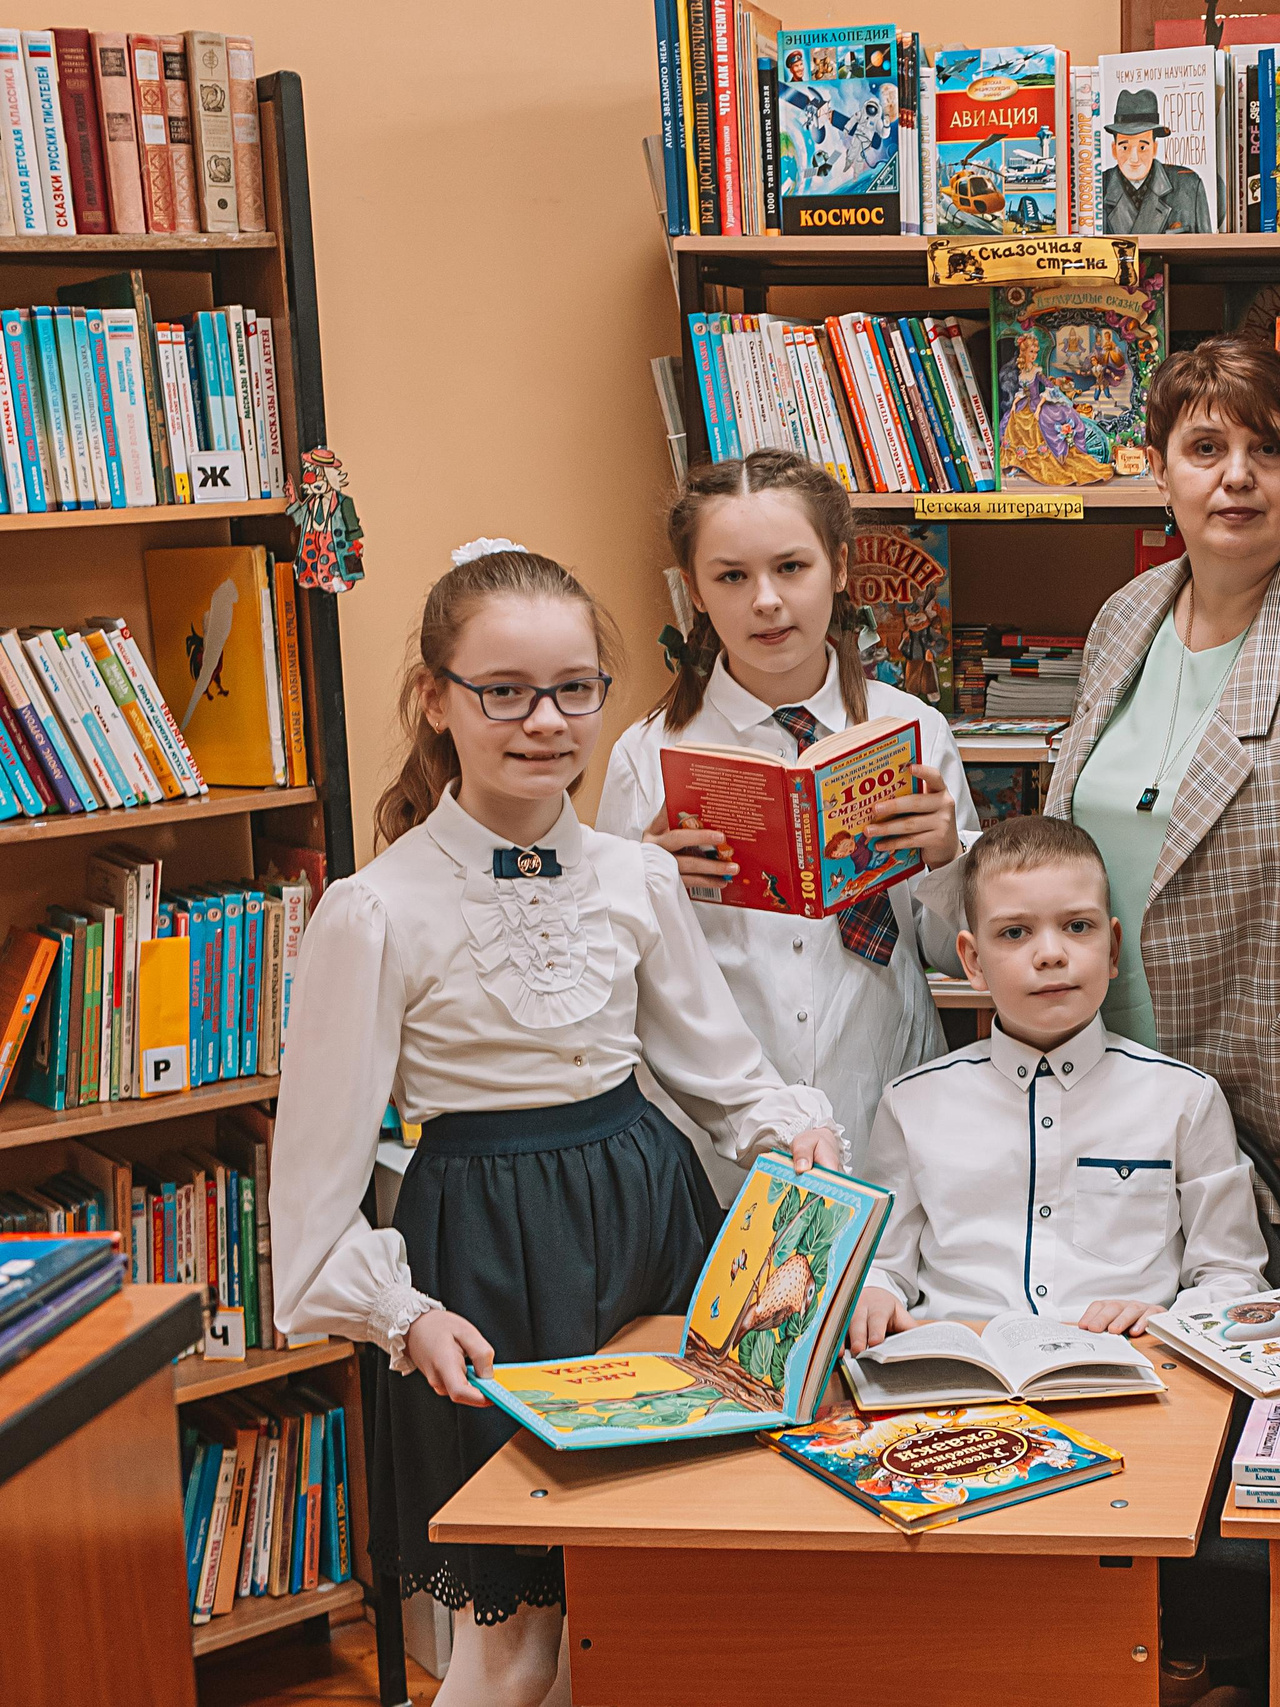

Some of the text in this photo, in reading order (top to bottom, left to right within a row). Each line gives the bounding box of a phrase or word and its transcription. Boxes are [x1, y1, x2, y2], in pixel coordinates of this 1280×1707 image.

[785, 28, 890, 48] ЭНЦИКЛОПЕДИЯ
[713, 0, 729, 116] ЧТО, КАК И ПОЧЕМУ?
[1115, 63, 1207, 83] ЧЕМУ Я МОГУ НАУЧИТЬСЯ
[658, 40, 674, 148] АТЛАС ЗВЕЗДНОГО НЕБА
[950, 107, 1039, 129] АВИАЦИЯ
[1162, 91, 1206, 134] СЕРГЕЯ
[1077, 112, 1093, 146] МИР
[4, 67, 36, 230] РУССКАЯ ДЕТСКАЯ КЛАССИКА
[34, 66, 69, 228] СКАЗКИ РУССКИХ ПИСАТЕЛЕЙ
[695, 101, 716, 195] ДОСТИЖЕНИЯ
[763, 85, 776, 215] 1000 тайн планеты Земля
[1163, 135, 1207, 167] КОРОЛЁВА
[721, 125, 735, 230] Удивительный мир техники
[1078, 149, 1094, 213] ПОЗНАЮ
[701, 199, 714, 225] ВСЕ
[800, 207, 885, 228] КОСМОС
[1025, 199, 1035, 218] NAVY
[978, 239, 1082, 262] Сказочная
[1036, 254, 1109, 274] страна
[259, 329, 280, 456] РАССКАЗЫ ДЛЯ ДЕТЕЙ
[876, 393, 888, 424] ЧТЕНИЕ
[885, 427, 907, 485] ВНЕКЛАССНОЕ
[198, 466, 231, 487] Ж
[914, 497, 1084, 519] Детская литература
[827, 777, 908, 820] СМЕШНЫХ
[840, 767, 895, 806] 100
[801, 870, 816, 901] 100
[153, 1059, 171, 1082] Р
[562, 1371, 637, 1385] ЛИСА
[896, 1429, 999, 1460] сказки
[910, 1437, 1009, 1468] волшебные
[933, 1448, 1011, 1474] Русские
